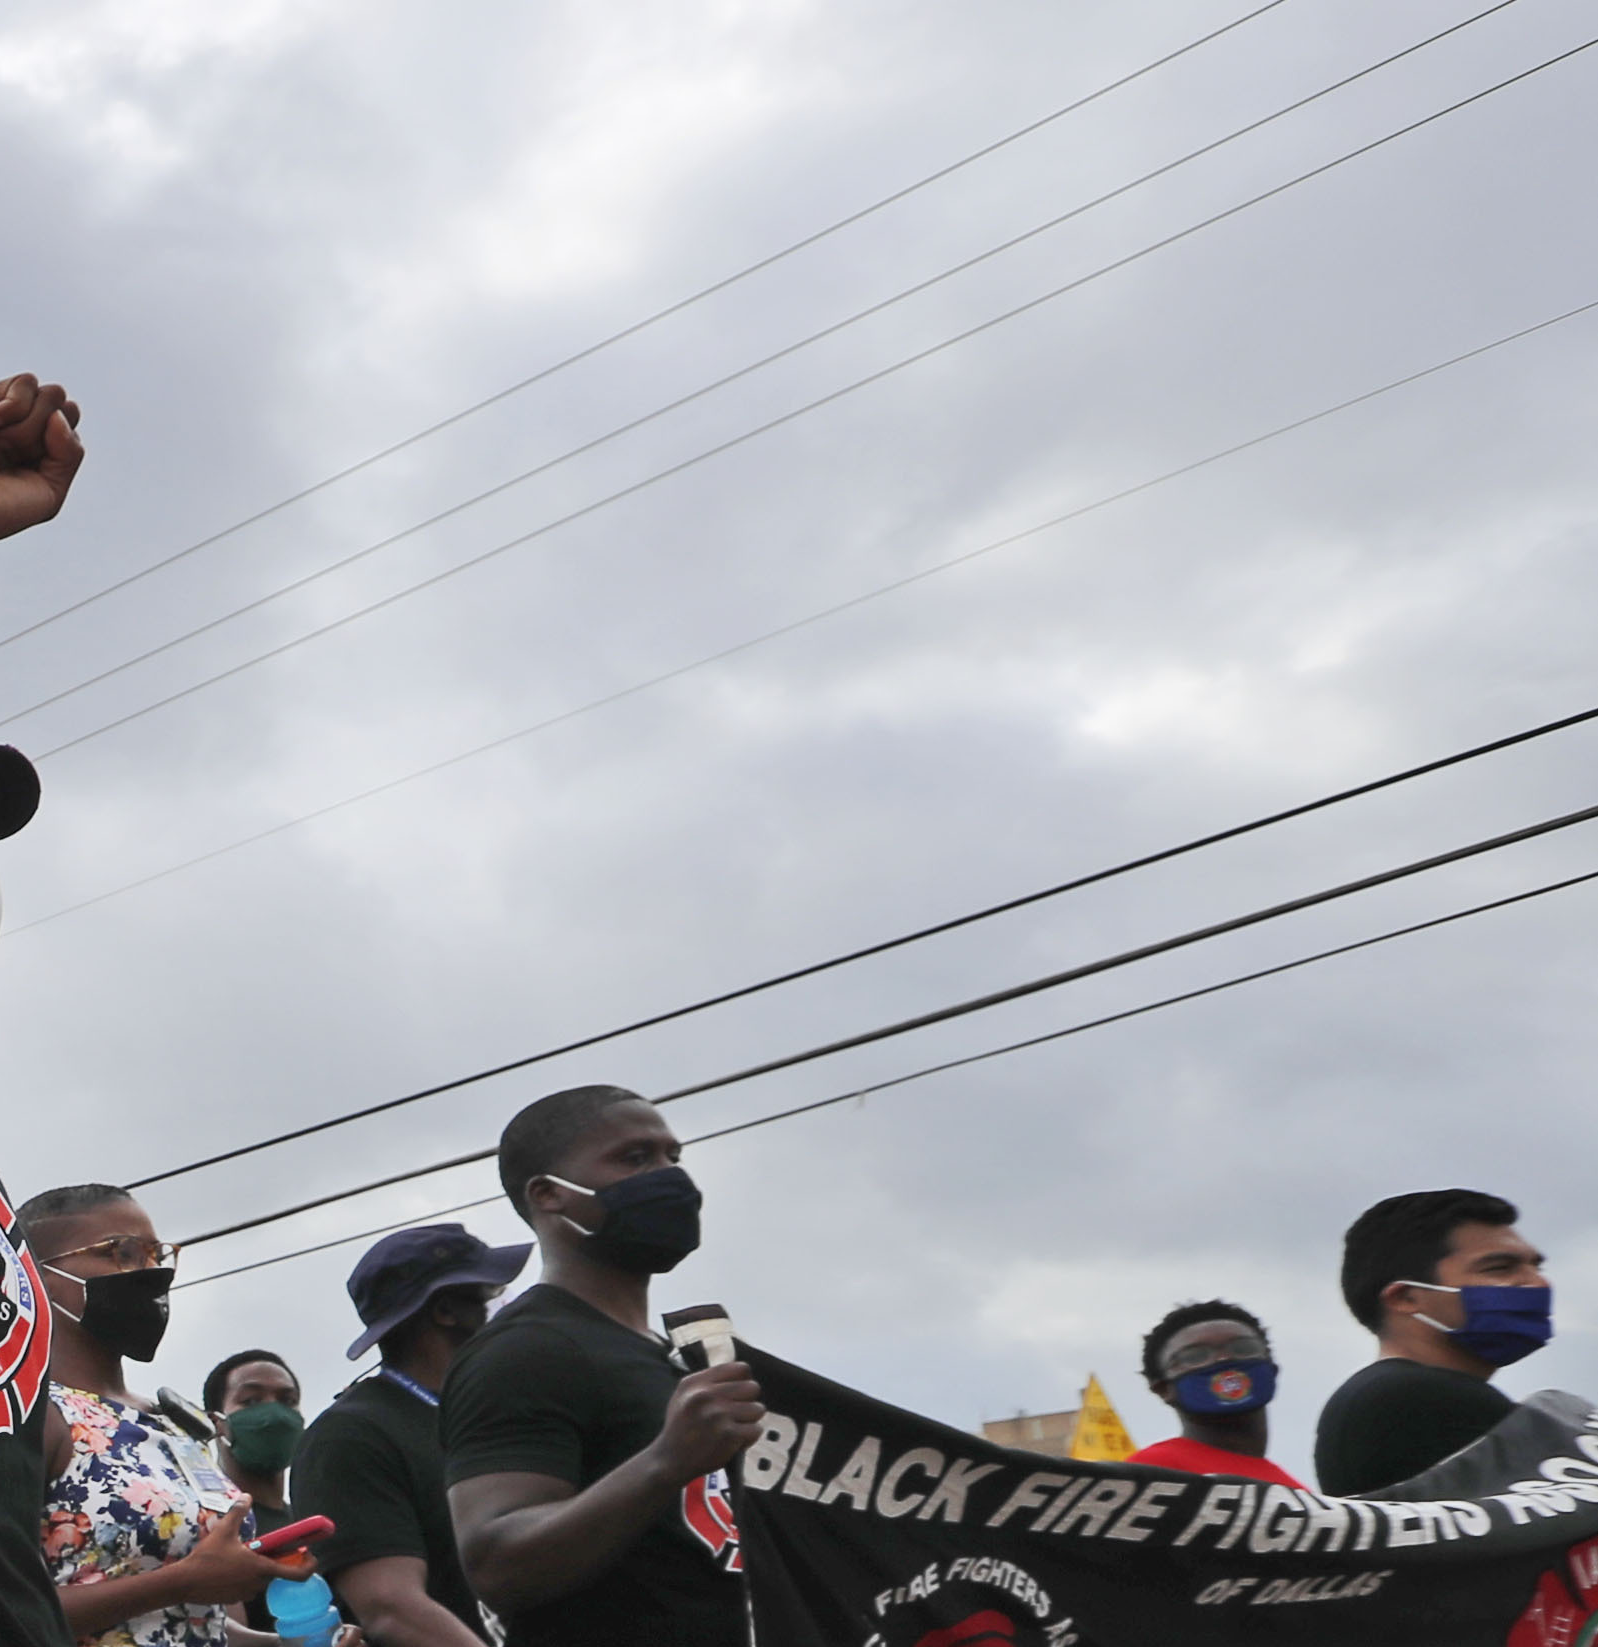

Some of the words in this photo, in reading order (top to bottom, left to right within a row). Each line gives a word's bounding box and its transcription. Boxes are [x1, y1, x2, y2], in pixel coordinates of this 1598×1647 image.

[742, 1410, 1005, 1523] BLACK
[985, 1472, 1188, 1543] FIRE
[1172, 1483, 1492, 1554] FIGHTERS
[945, 1556, 1052, 1619] FIGHTERS
[1194, 1577, 1259, 1606] OF
[1249, 1569, 1397, 1606] DALLAS
